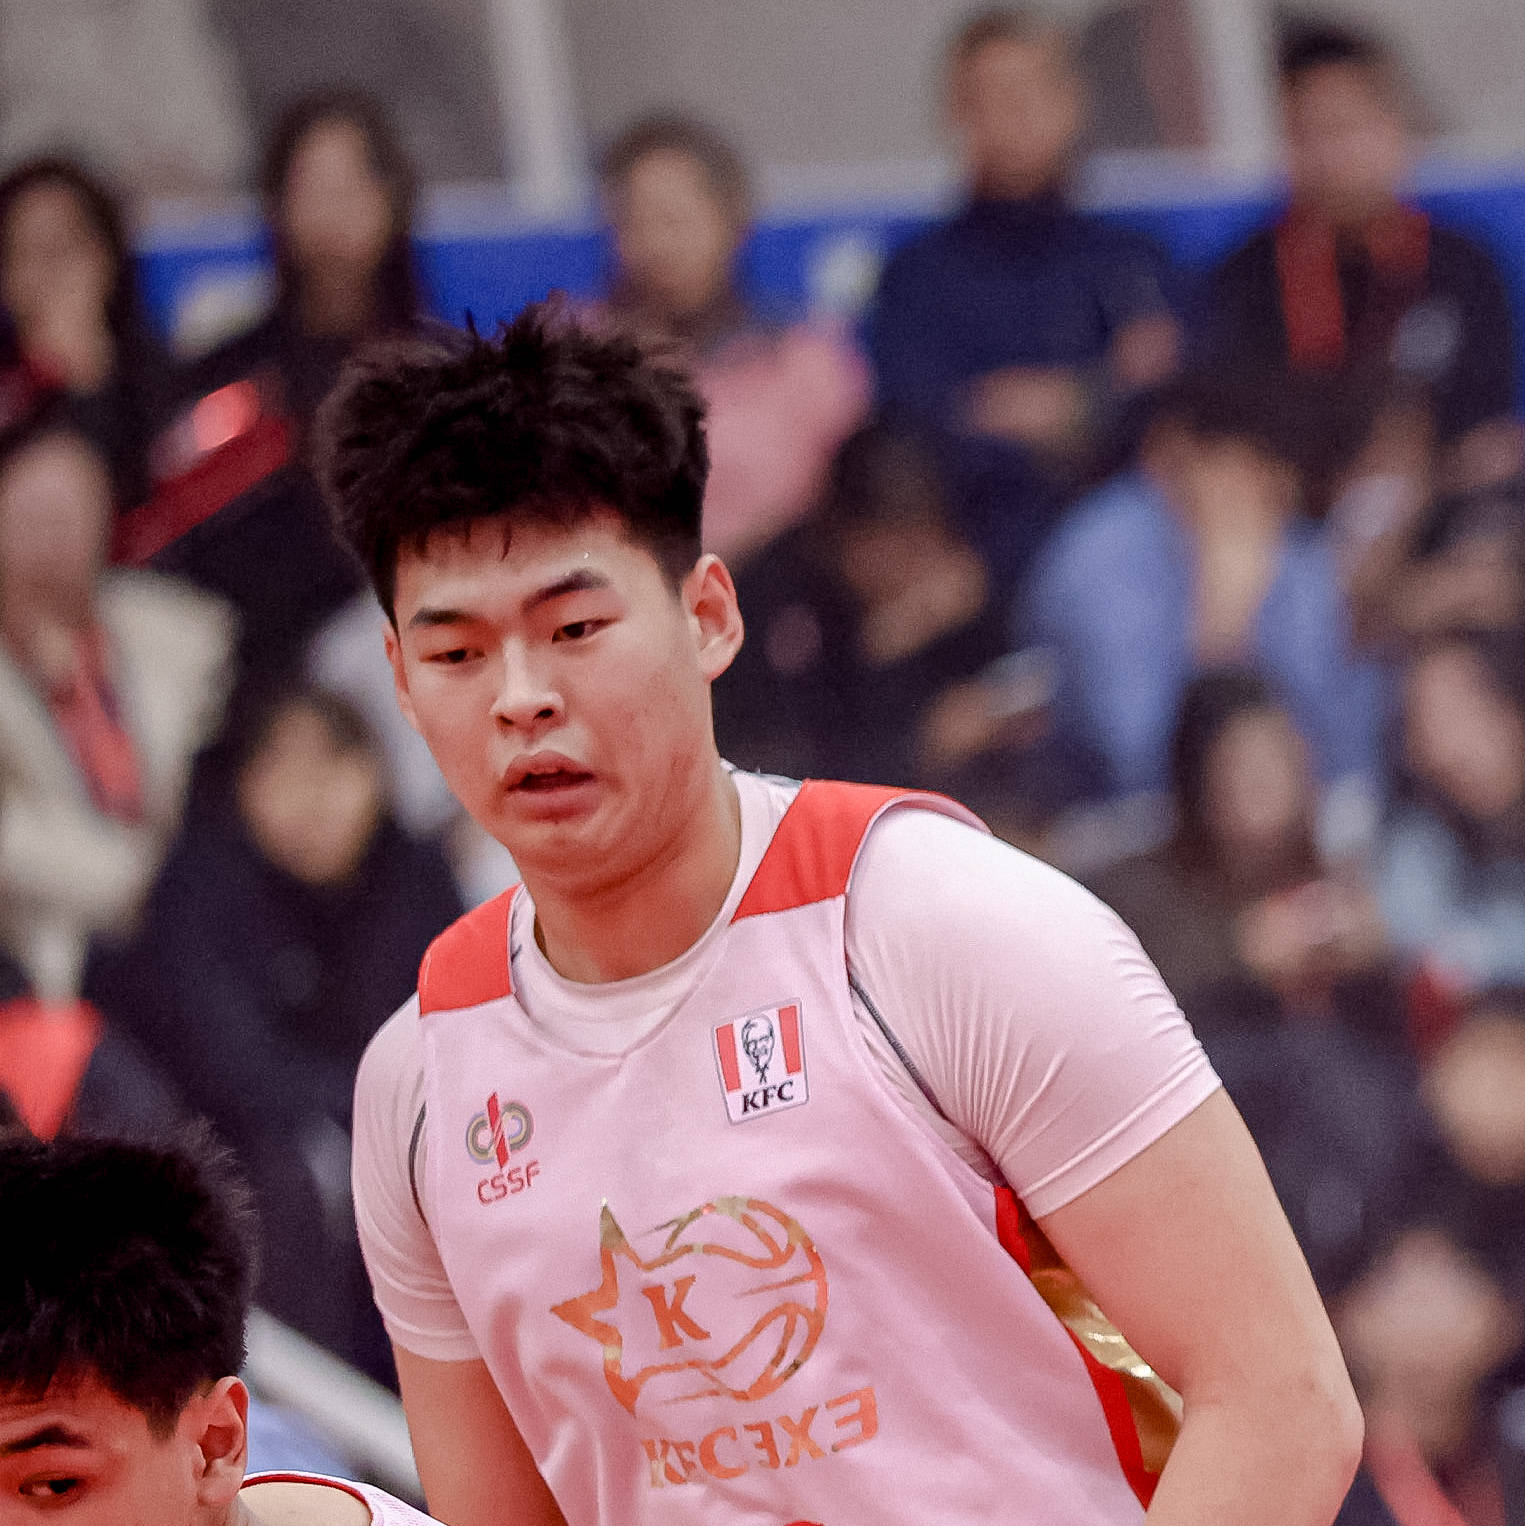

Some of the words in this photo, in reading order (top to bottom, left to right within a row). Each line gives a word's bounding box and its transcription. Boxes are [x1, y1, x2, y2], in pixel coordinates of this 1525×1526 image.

[740, 1080, 796, 1116] KFC
[477, 1164, 541, 1206] CSSF
[640, 1274, 711, 1350] K
